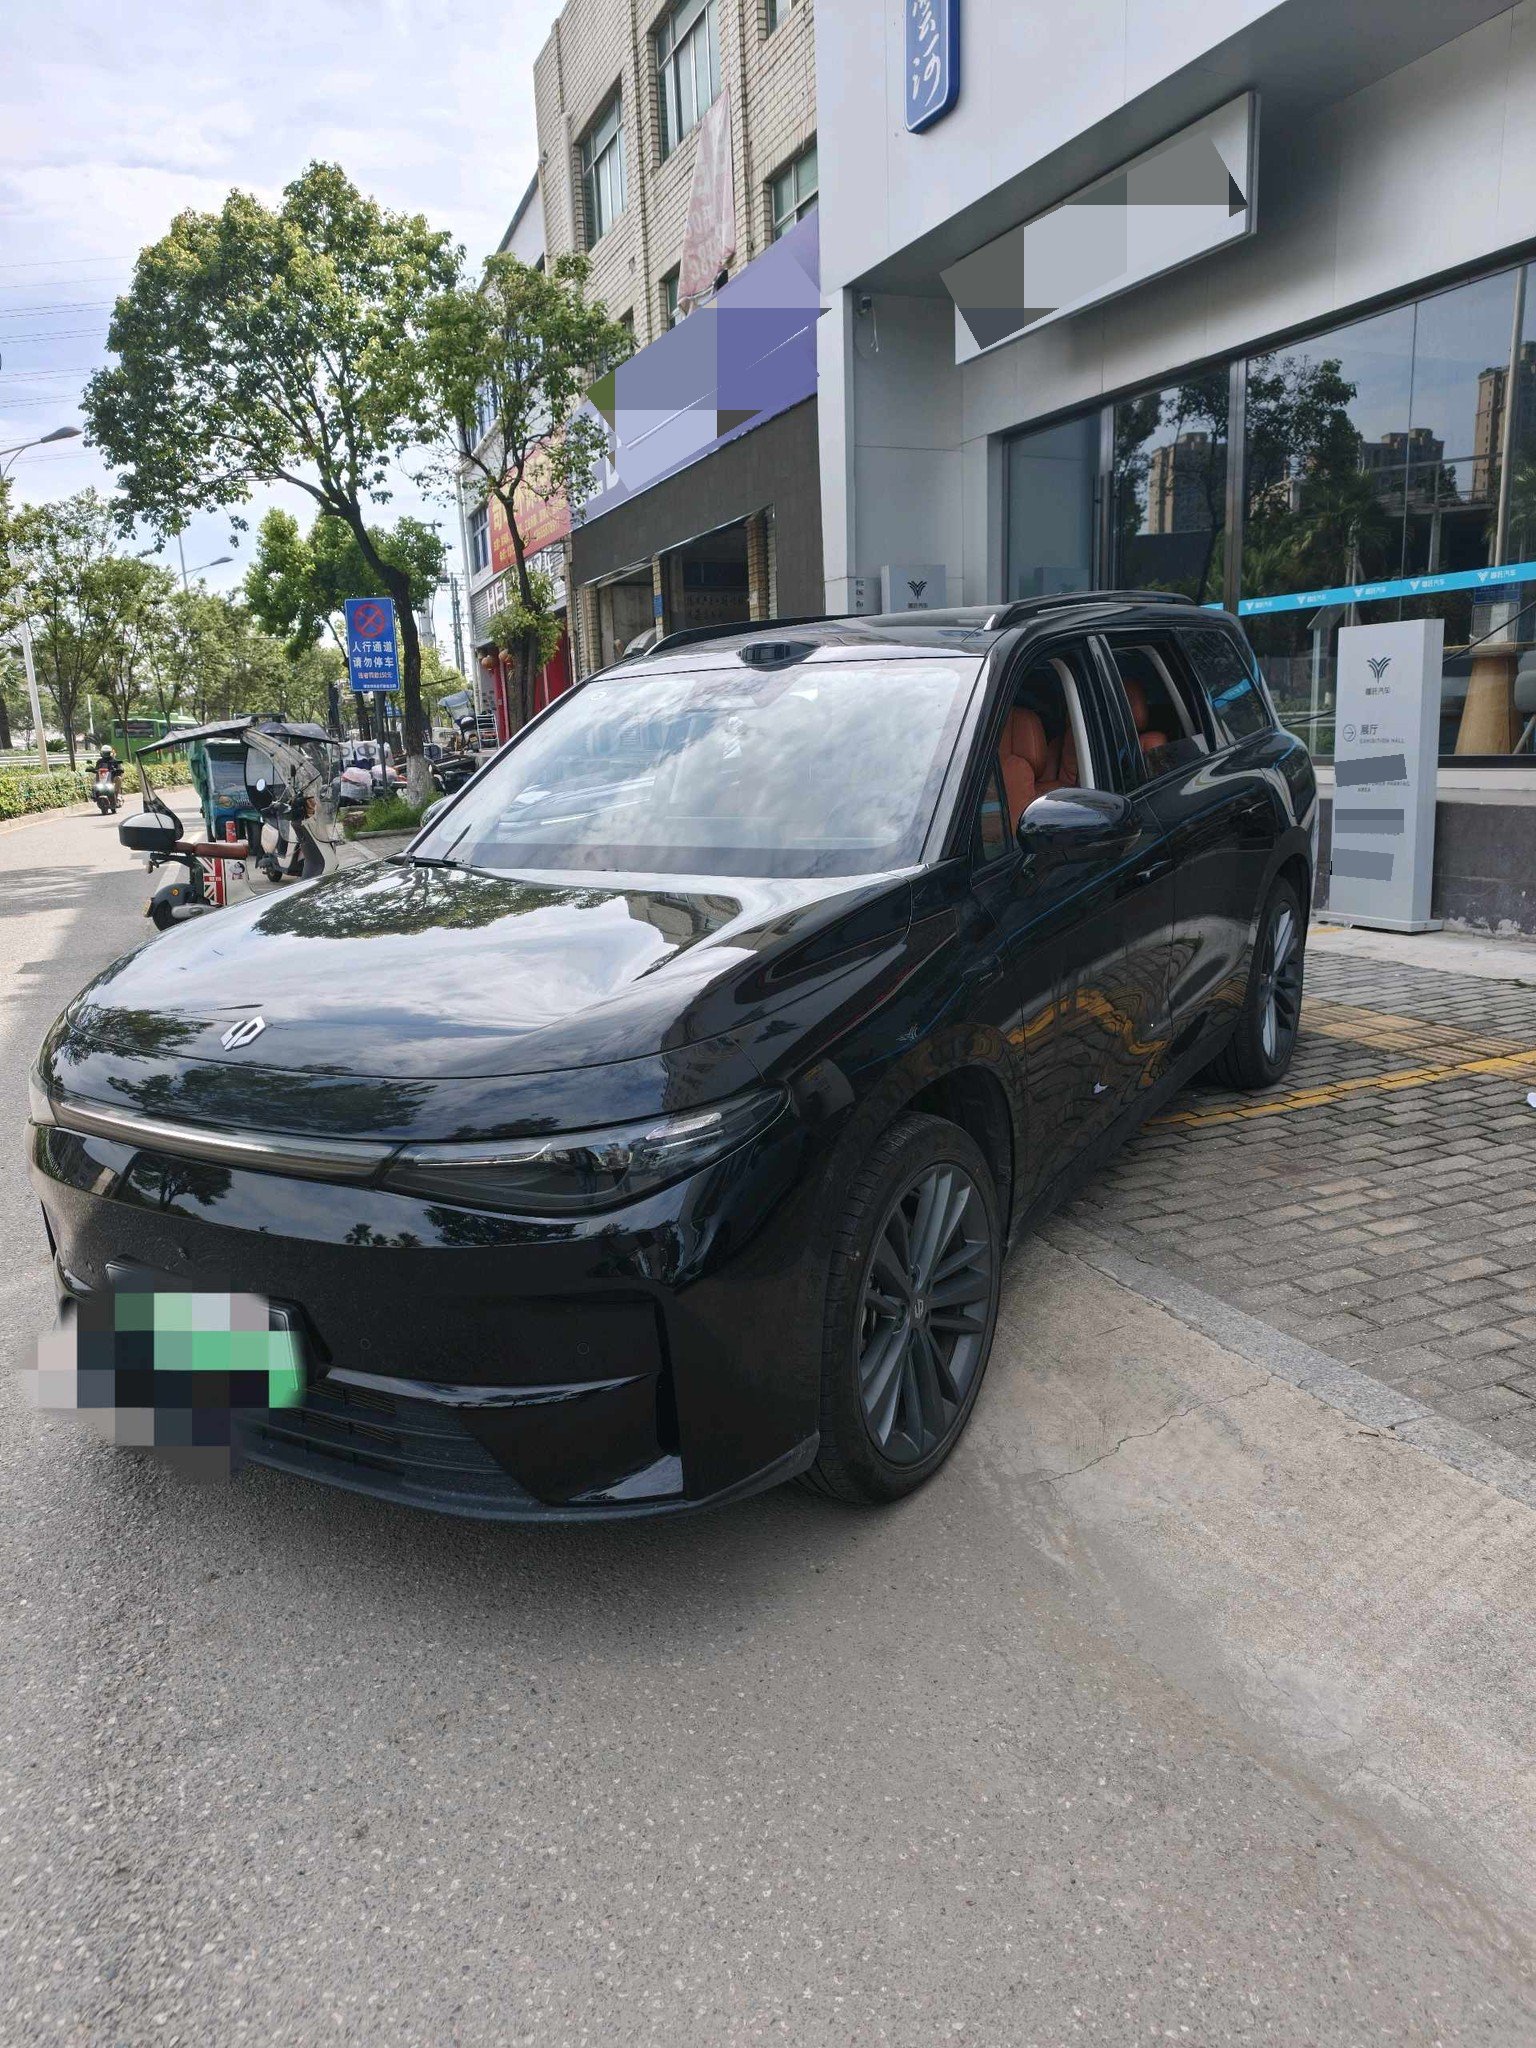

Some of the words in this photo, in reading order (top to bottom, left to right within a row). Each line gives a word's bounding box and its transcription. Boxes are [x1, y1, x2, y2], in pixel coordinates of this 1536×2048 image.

[352, 640, 393, 653] 人行通道
[353, 656, 395, 668] 请勿停车
[1360, 724, 1379, 735] 展厅
